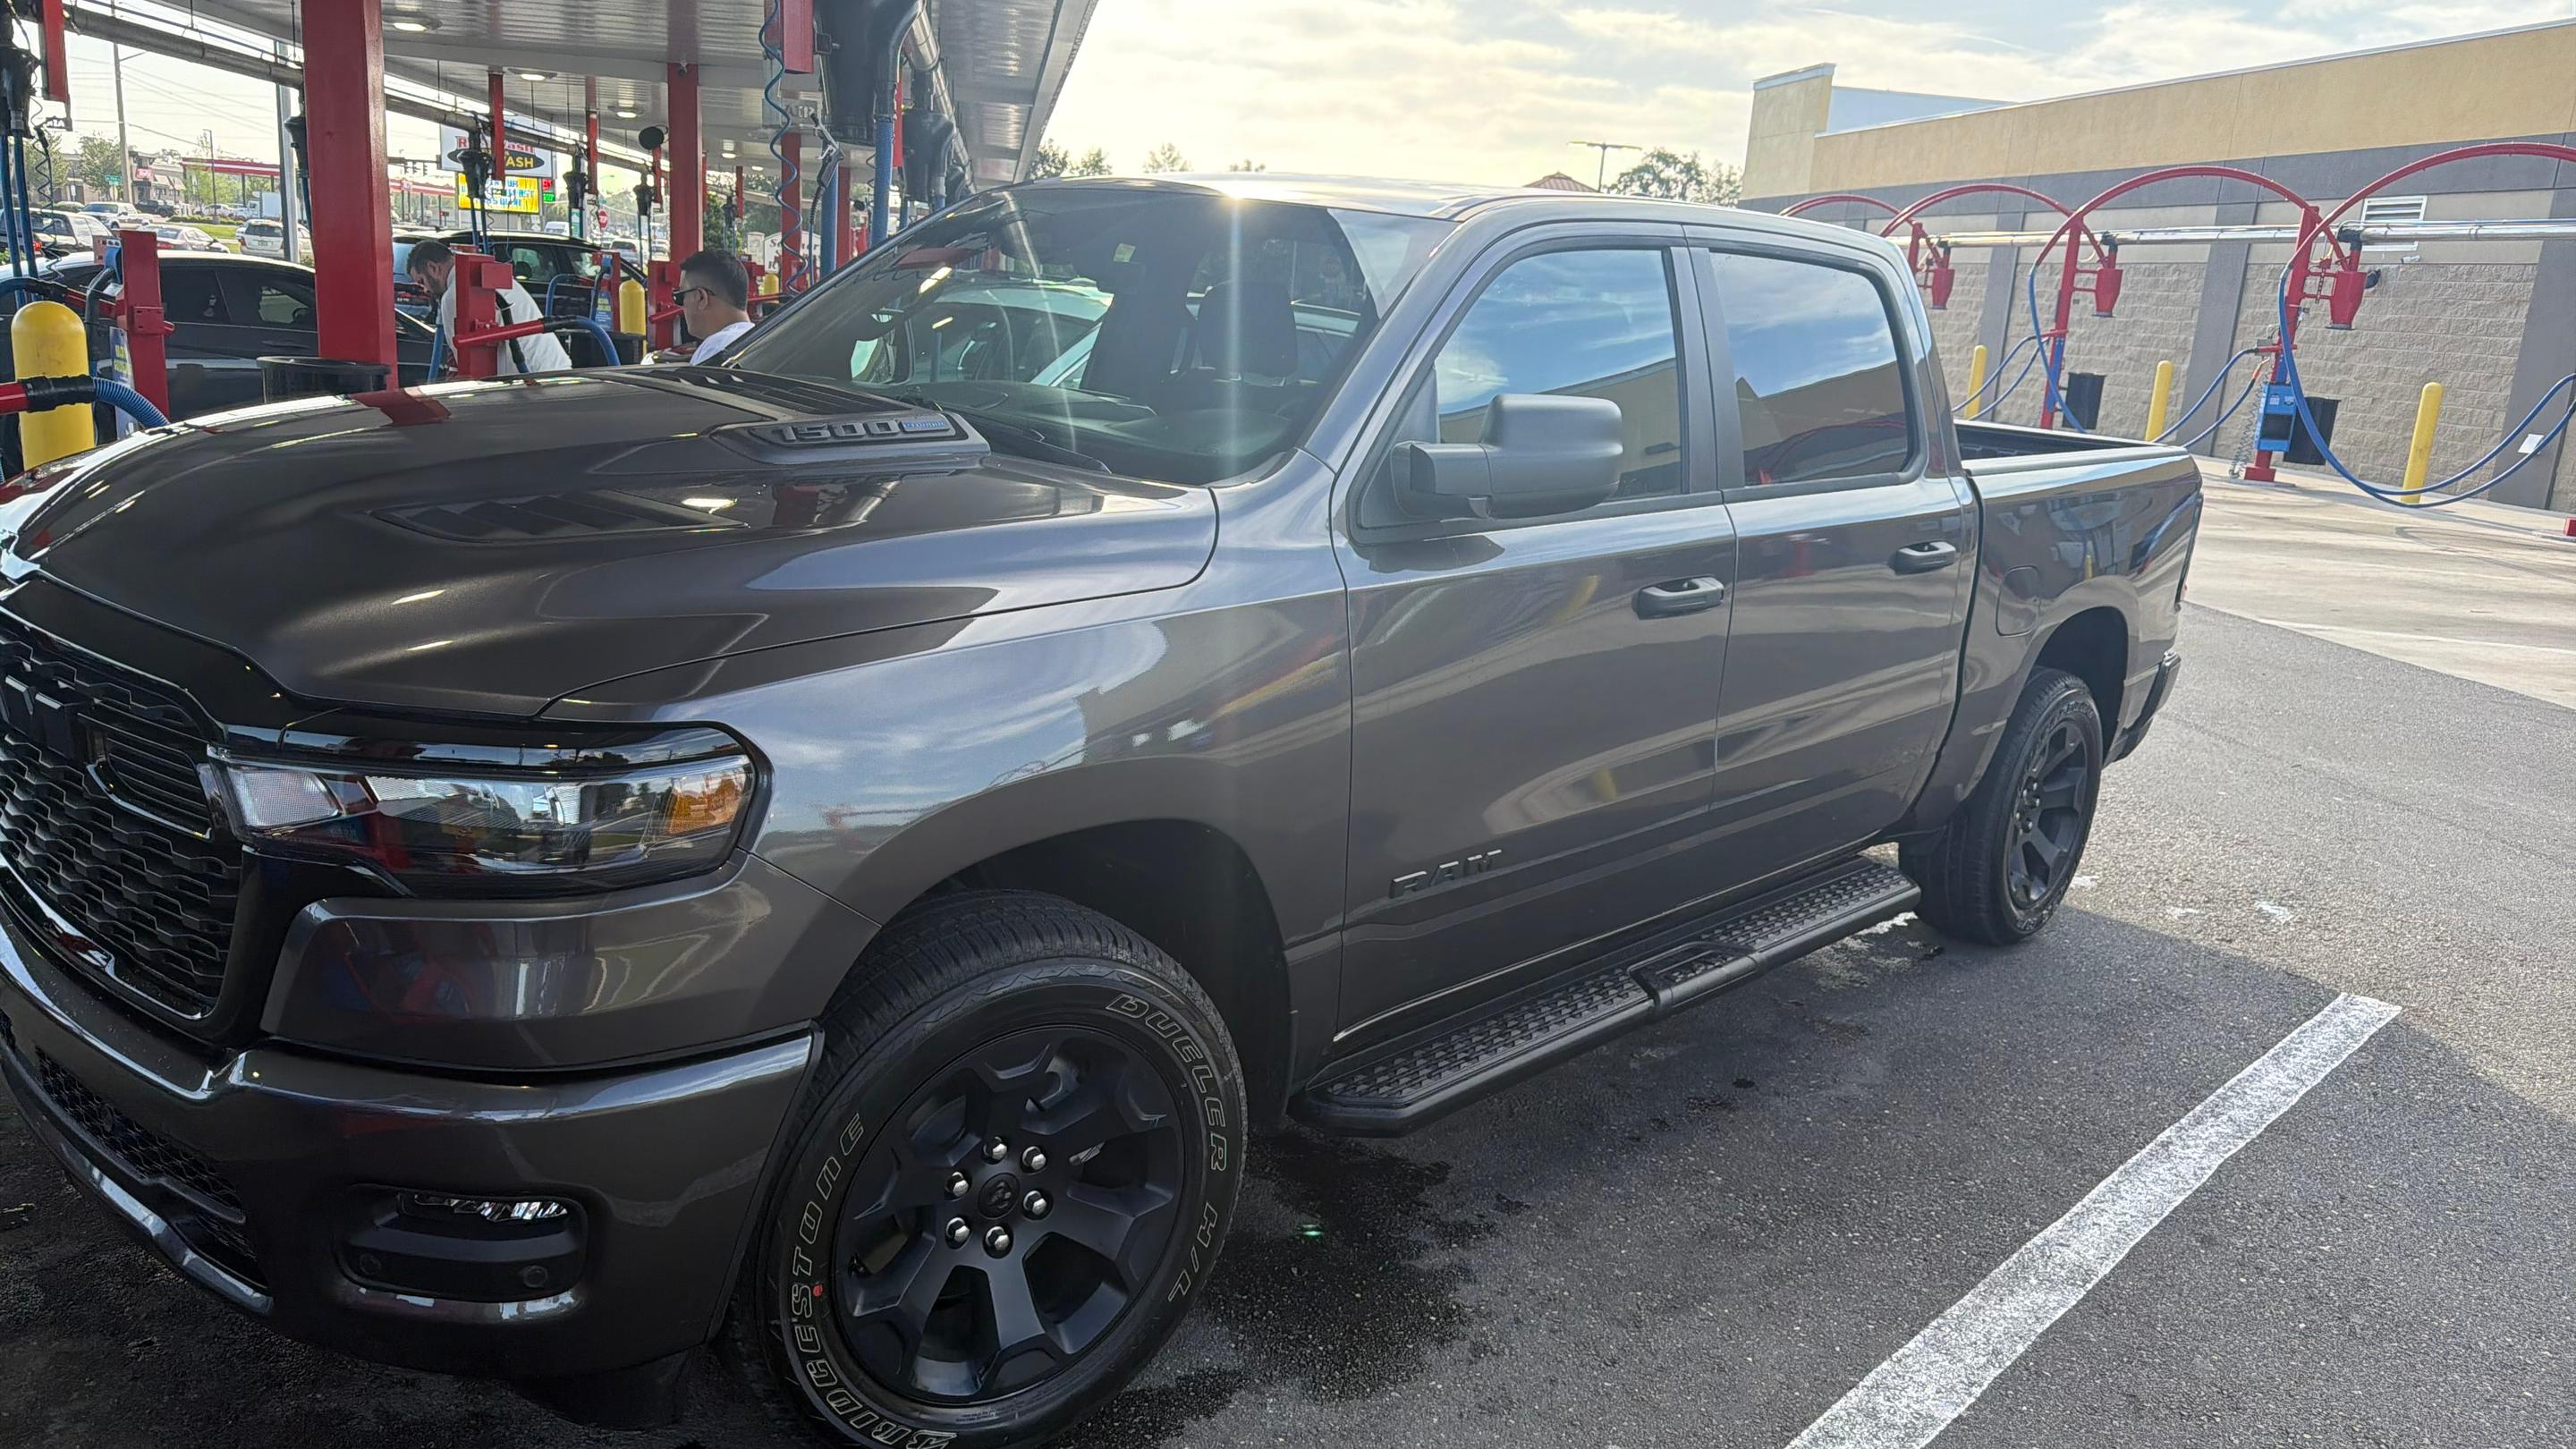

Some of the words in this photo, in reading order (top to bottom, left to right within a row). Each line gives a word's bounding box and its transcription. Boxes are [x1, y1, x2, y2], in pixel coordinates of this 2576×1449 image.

[504, 157, 534, 168] ASH
[775, 419, 901, 443] 1500
[1390, 849, 1503, 899] RAM
[1106, 993, 1227, 1172] DUELER
